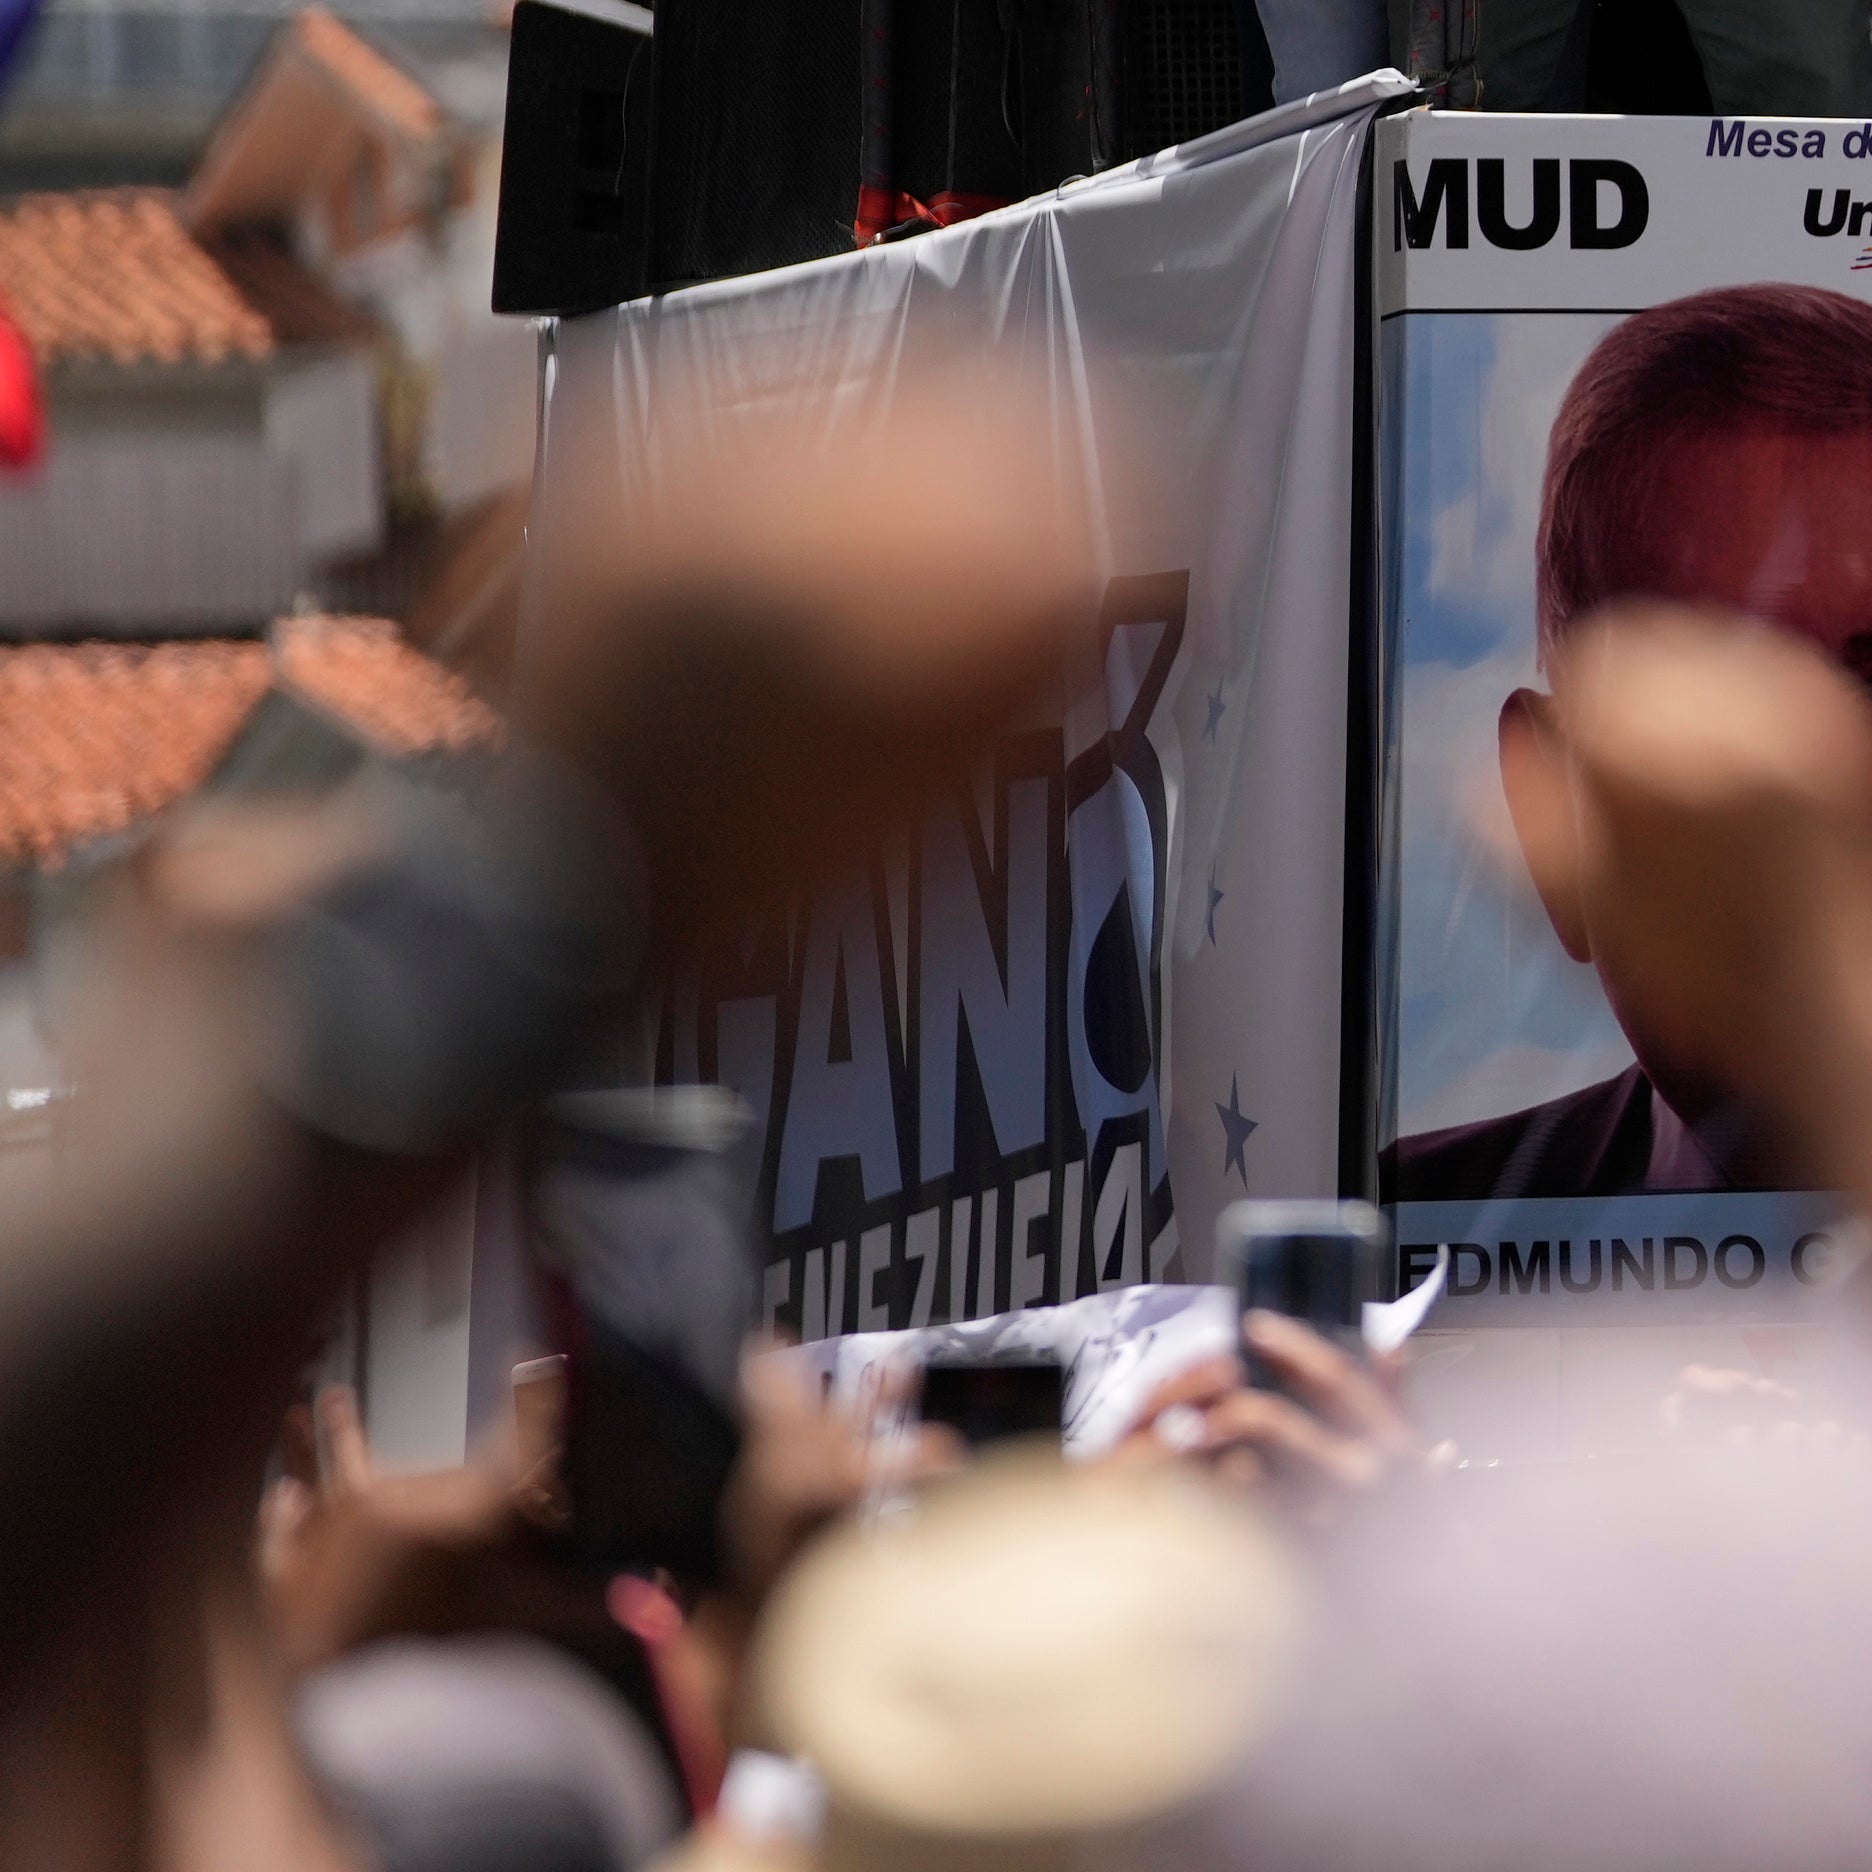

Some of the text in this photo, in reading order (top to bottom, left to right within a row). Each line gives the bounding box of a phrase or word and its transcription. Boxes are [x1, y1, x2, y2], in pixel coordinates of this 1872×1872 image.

[1706, 120, 1826, 159] Mesa
[1393, 158, 1650, 252] MUD
[762, 1140, 1144, 1344] ENEZUELA
[1399, 1234, 1766, 1298] EDMUNDO
